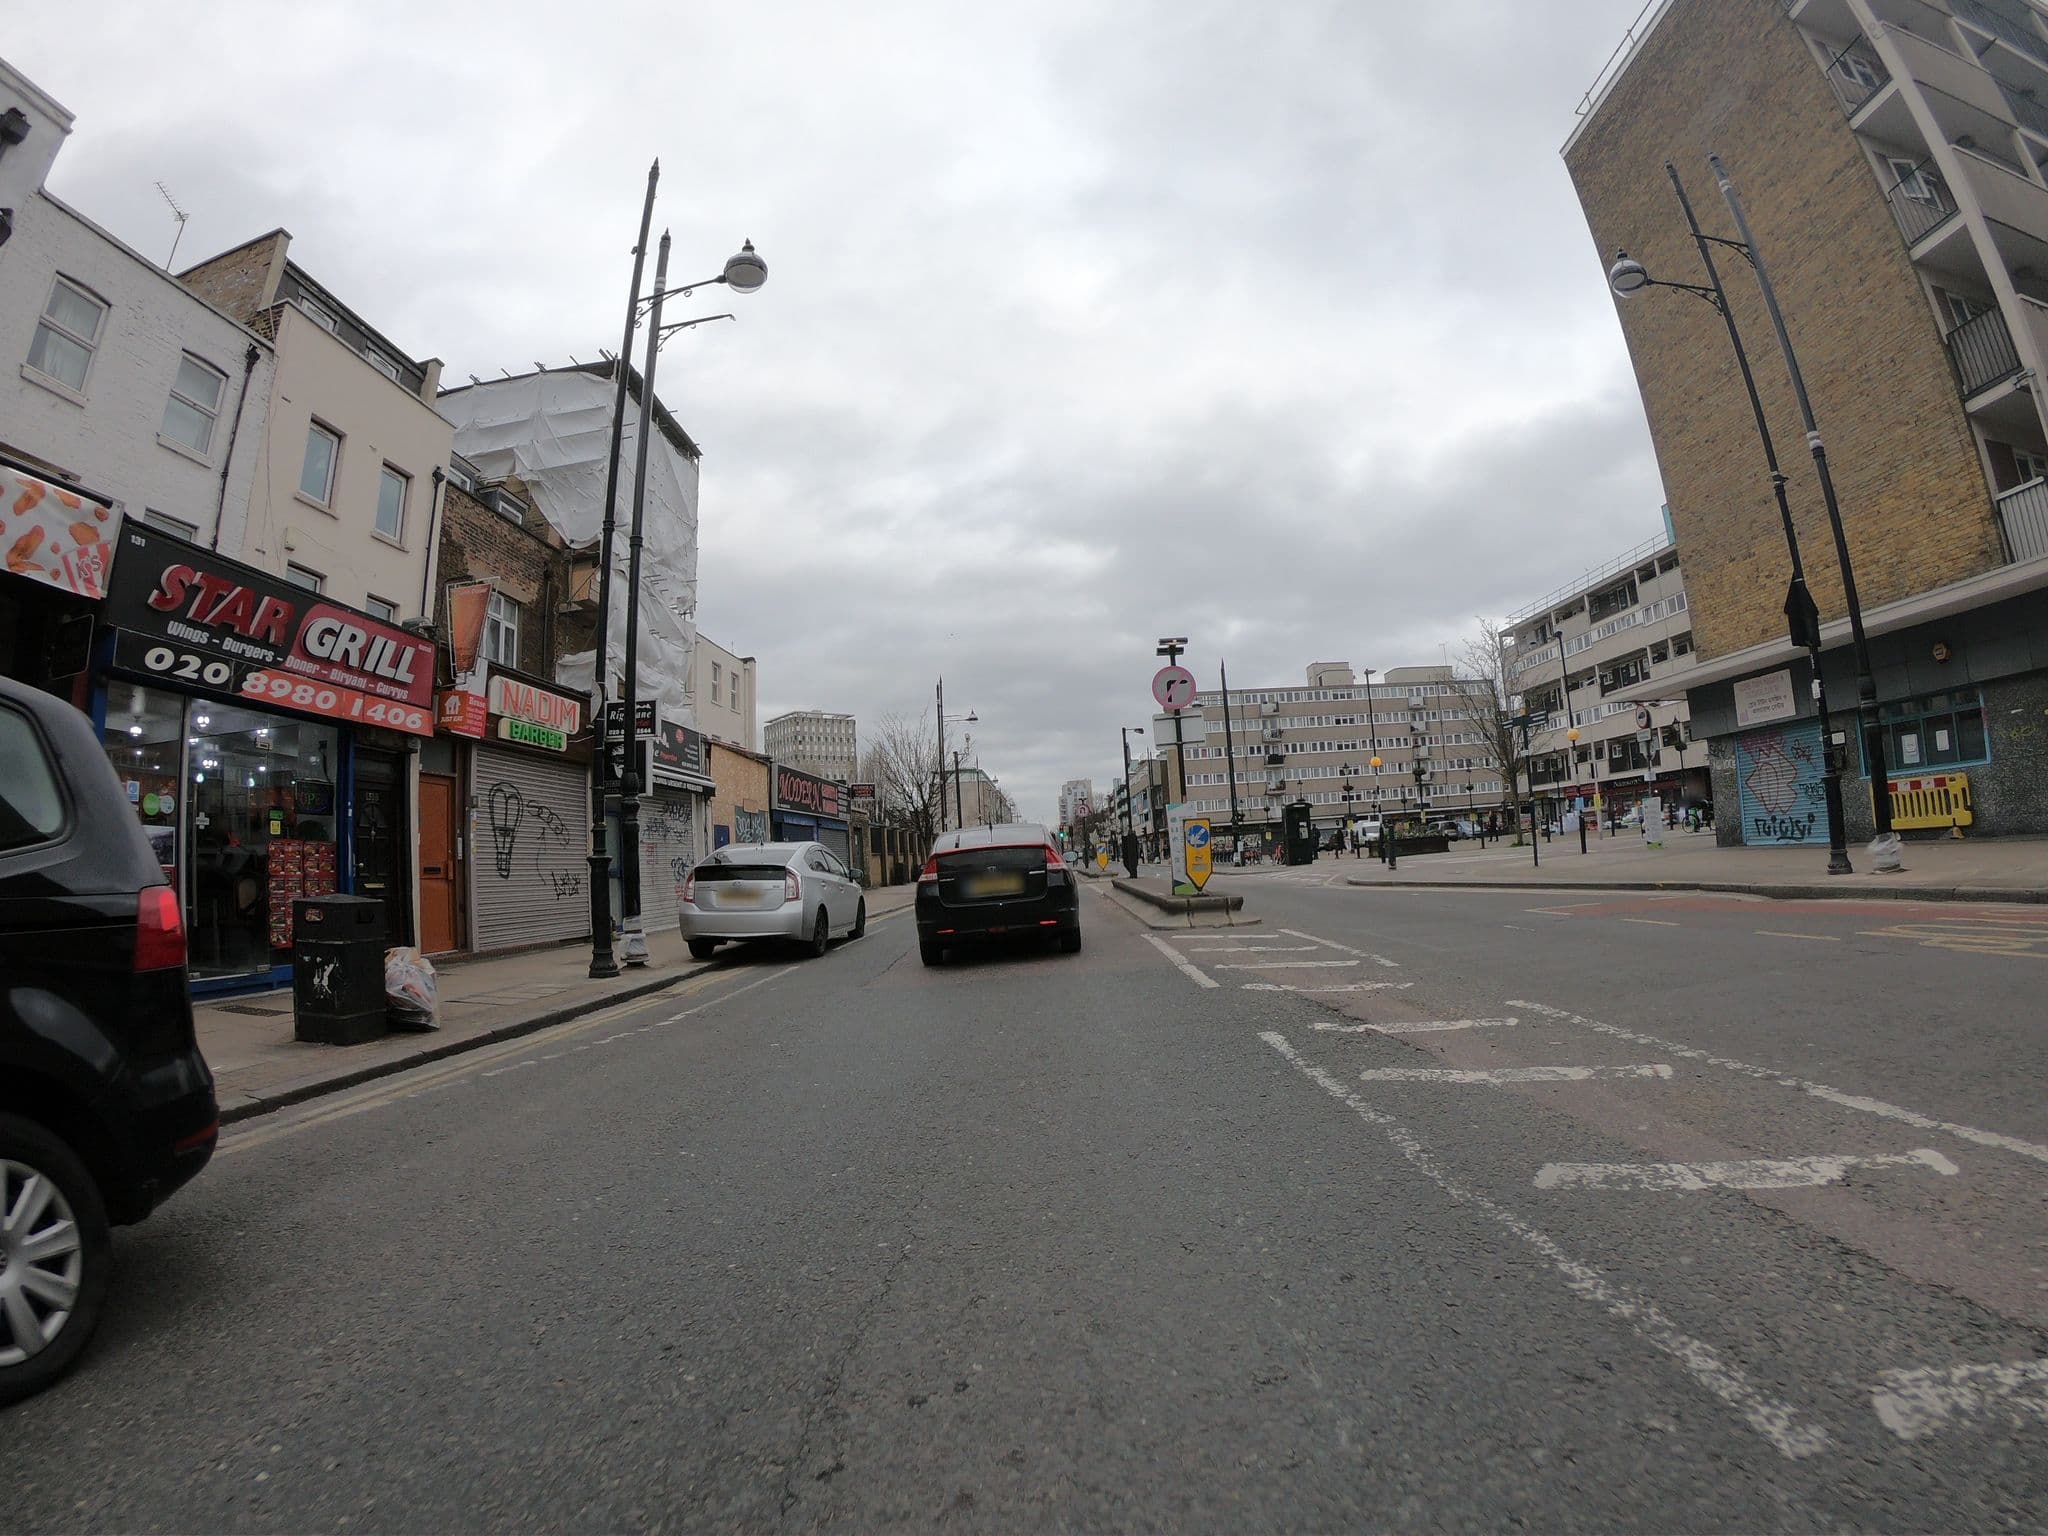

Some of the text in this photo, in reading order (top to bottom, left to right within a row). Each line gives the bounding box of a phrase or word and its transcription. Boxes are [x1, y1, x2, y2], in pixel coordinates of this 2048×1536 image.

[130, 534, 146, 547] 131
[147, 564, 417, 685] STAR GRILL
[166, 620, 211, 645] Wings
[222, 637, 275, 663] Burgers
[285, 654, 320, 675] Doner
[376, 681, 410, 701] Currys
[144, 647, 231, 685] 020
[241, 671, 337, 710] 8980
[350, 698, 423, 730] 1406
[502, 679, 578, 733] NADIM
[510, 719, 566, 749] BARBER
[778, 772, 823, 812] MODERN
